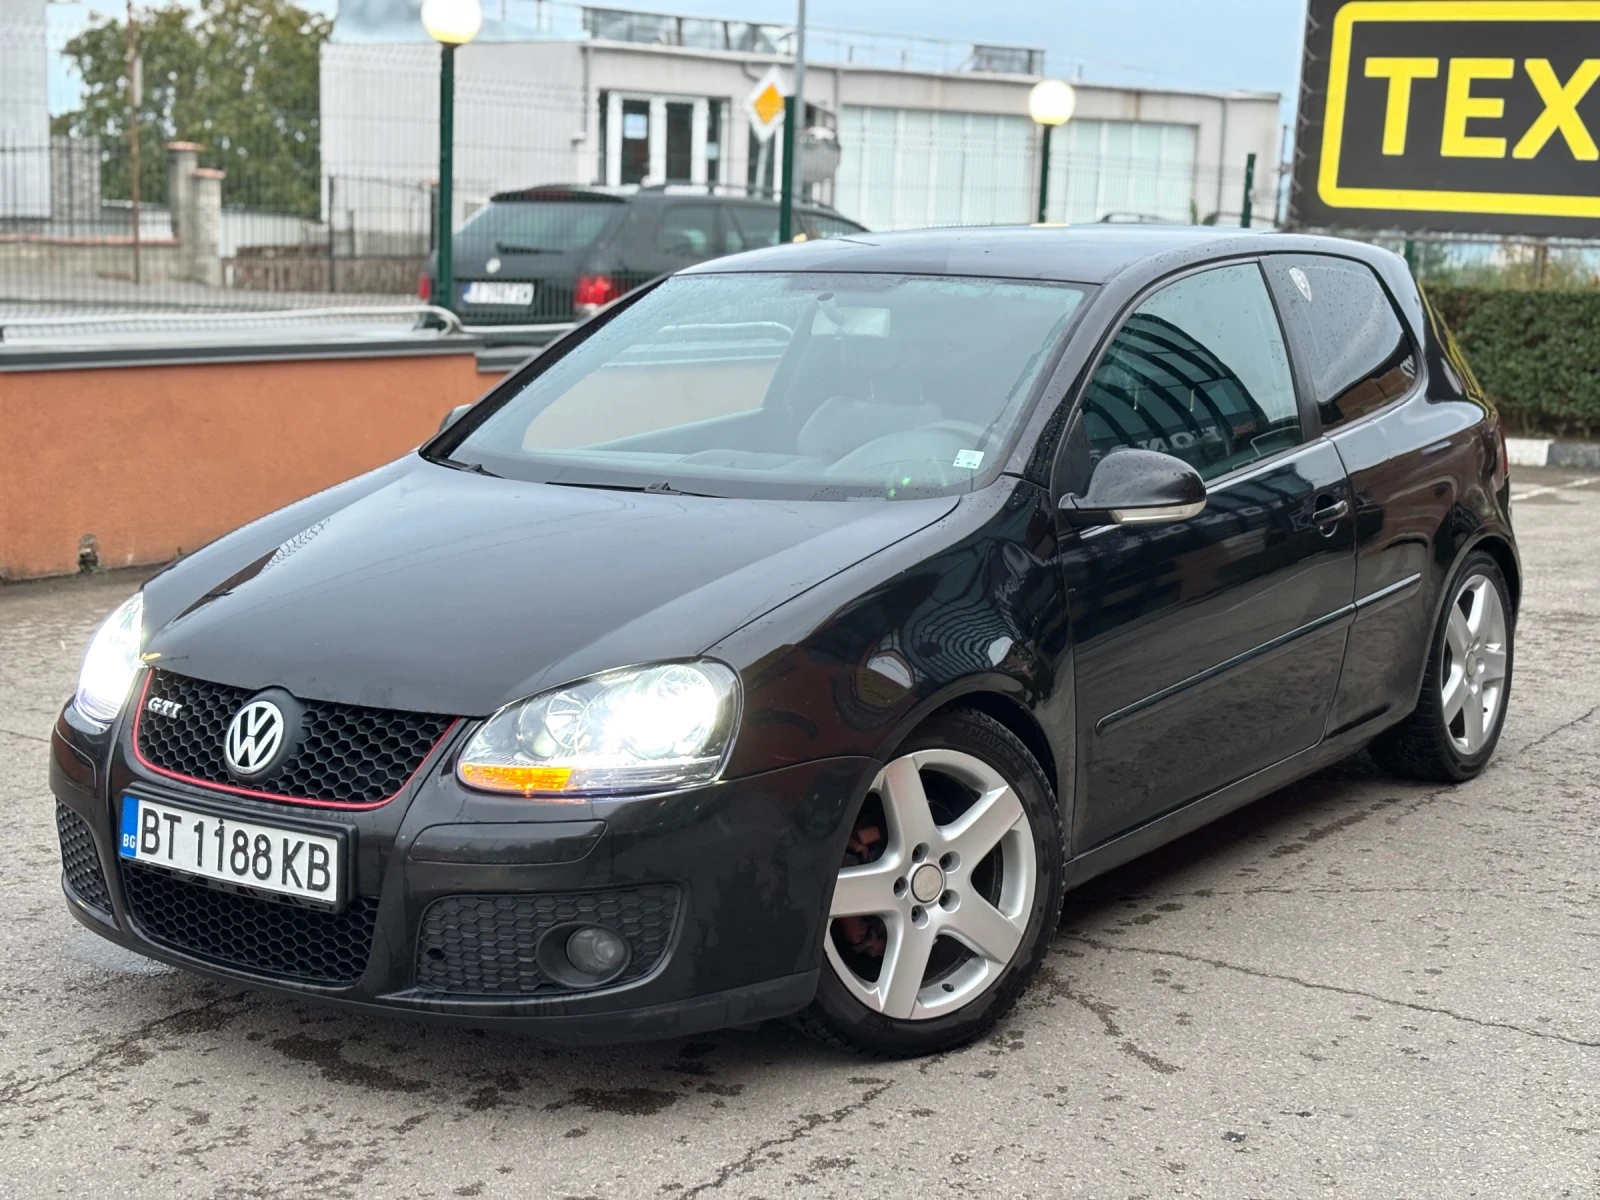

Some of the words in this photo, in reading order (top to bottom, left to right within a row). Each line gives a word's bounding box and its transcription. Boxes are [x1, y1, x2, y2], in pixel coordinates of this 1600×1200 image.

[1364, 57, 1600, 161] TEX
[148, 697, 182, 719] GTI
[122, 834, 136, 848] BG
[141, 808, 182, 860] BT
[194, 819, 272, 880] 1188
[281, 838, 330, 892] KB
